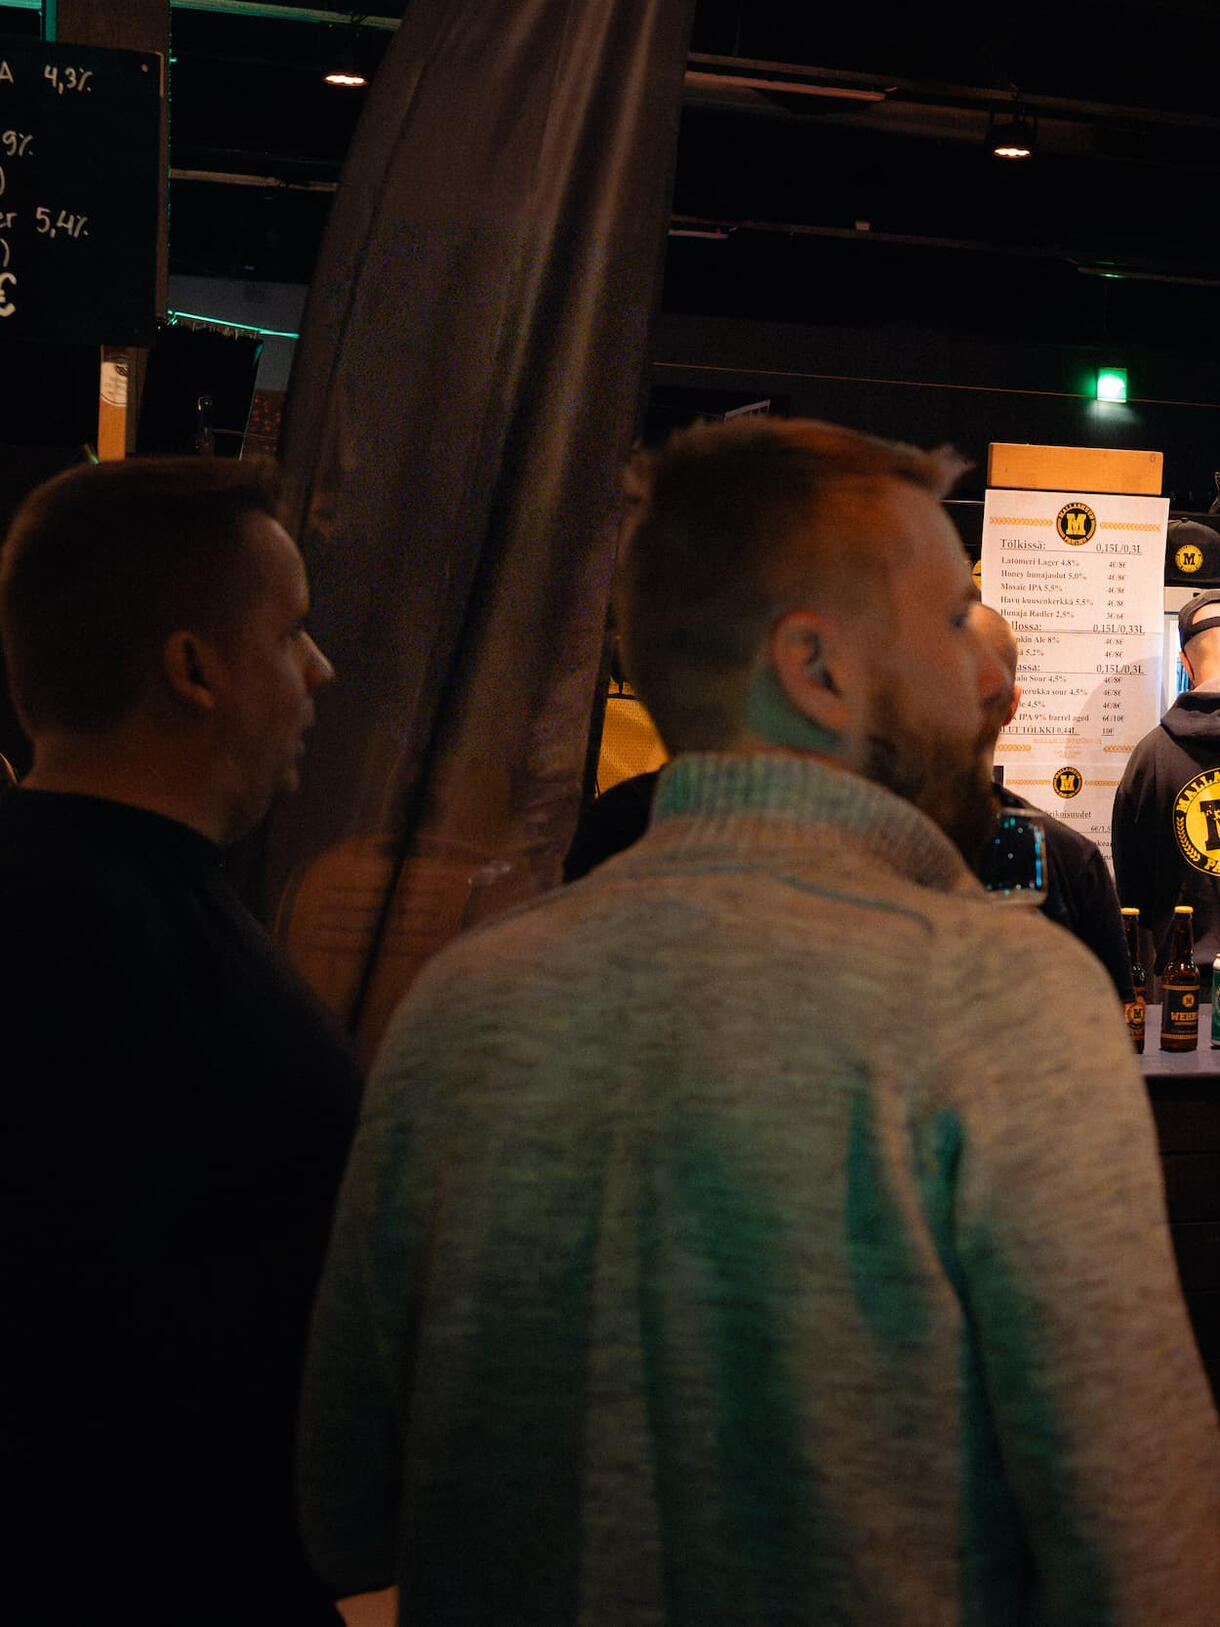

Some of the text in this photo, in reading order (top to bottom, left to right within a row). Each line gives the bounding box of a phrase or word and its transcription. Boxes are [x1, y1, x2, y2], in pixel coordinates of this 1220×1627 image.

[43, 64, 94, 95] 4,3%
[35, 205, 89, 239] 5,4%
[1001, 557, 1035, 566] Latomeri
[1038, 558, 1058, 568] Lager
[1184, 552, 1196, 566] M
[1001, 570, 1024, 579] Honey
[1000, 583, 1026, 592] Mosaic
[1028, 583, 1042, 592] IPA
[1000, 609, 1028, 619] Hunaja
[1029, 610, 1053, 618] Radler
[1011, 620, 1042, 631] llossa:
[1017, 663, 1040, 672] assa:
[1029, 674, 1046, 682] Sour
[1019, 713, 1033, 721] IPA
[1048, 713, 1071, 721] barrel
[1049, 809, 1092, 818] rikoisuudet
